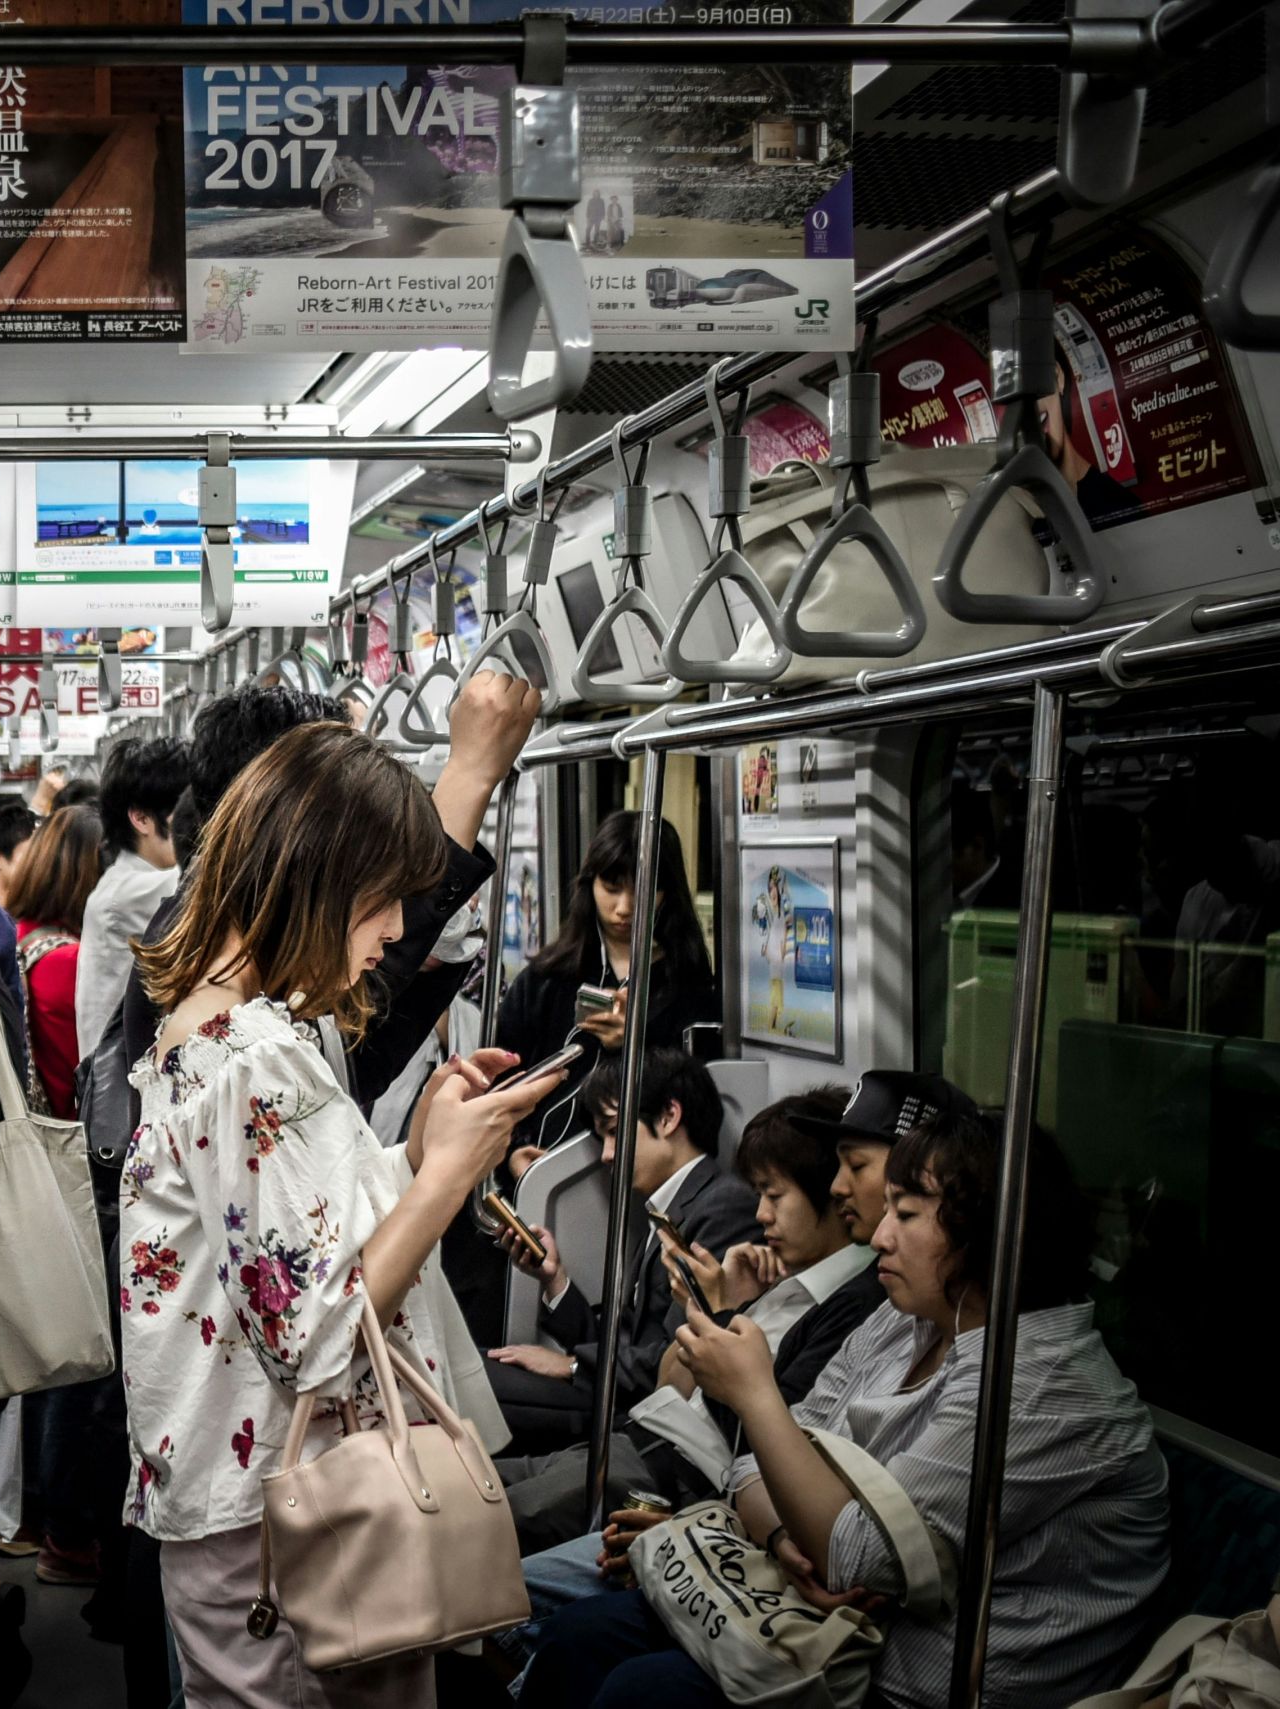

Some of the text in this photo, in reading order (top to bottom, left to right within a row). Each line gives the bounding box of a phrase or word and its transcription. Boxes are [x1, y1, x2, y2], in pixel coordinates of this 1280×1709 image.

[208, 86, 497, 136] FESTIVAL
[205, 139, 338, 190] 2017
[297, 275, 392, 291] Reborn-Art
[398, 275, 462, 291] Festival
[297, 296, 454, 314] JRをご利用ください。
[795, 299, 830, 319] JR
[103, 321, 134, 333] 長谷工
[138, 321, 183, 333] アーベスト
[1131, 390, 1159, 422] Speed
[1165, 382, 1193, 406] value.
[1157, 438, 1227, 484] モビット
[655, 1536, 727, 1641] PRODUCTS
